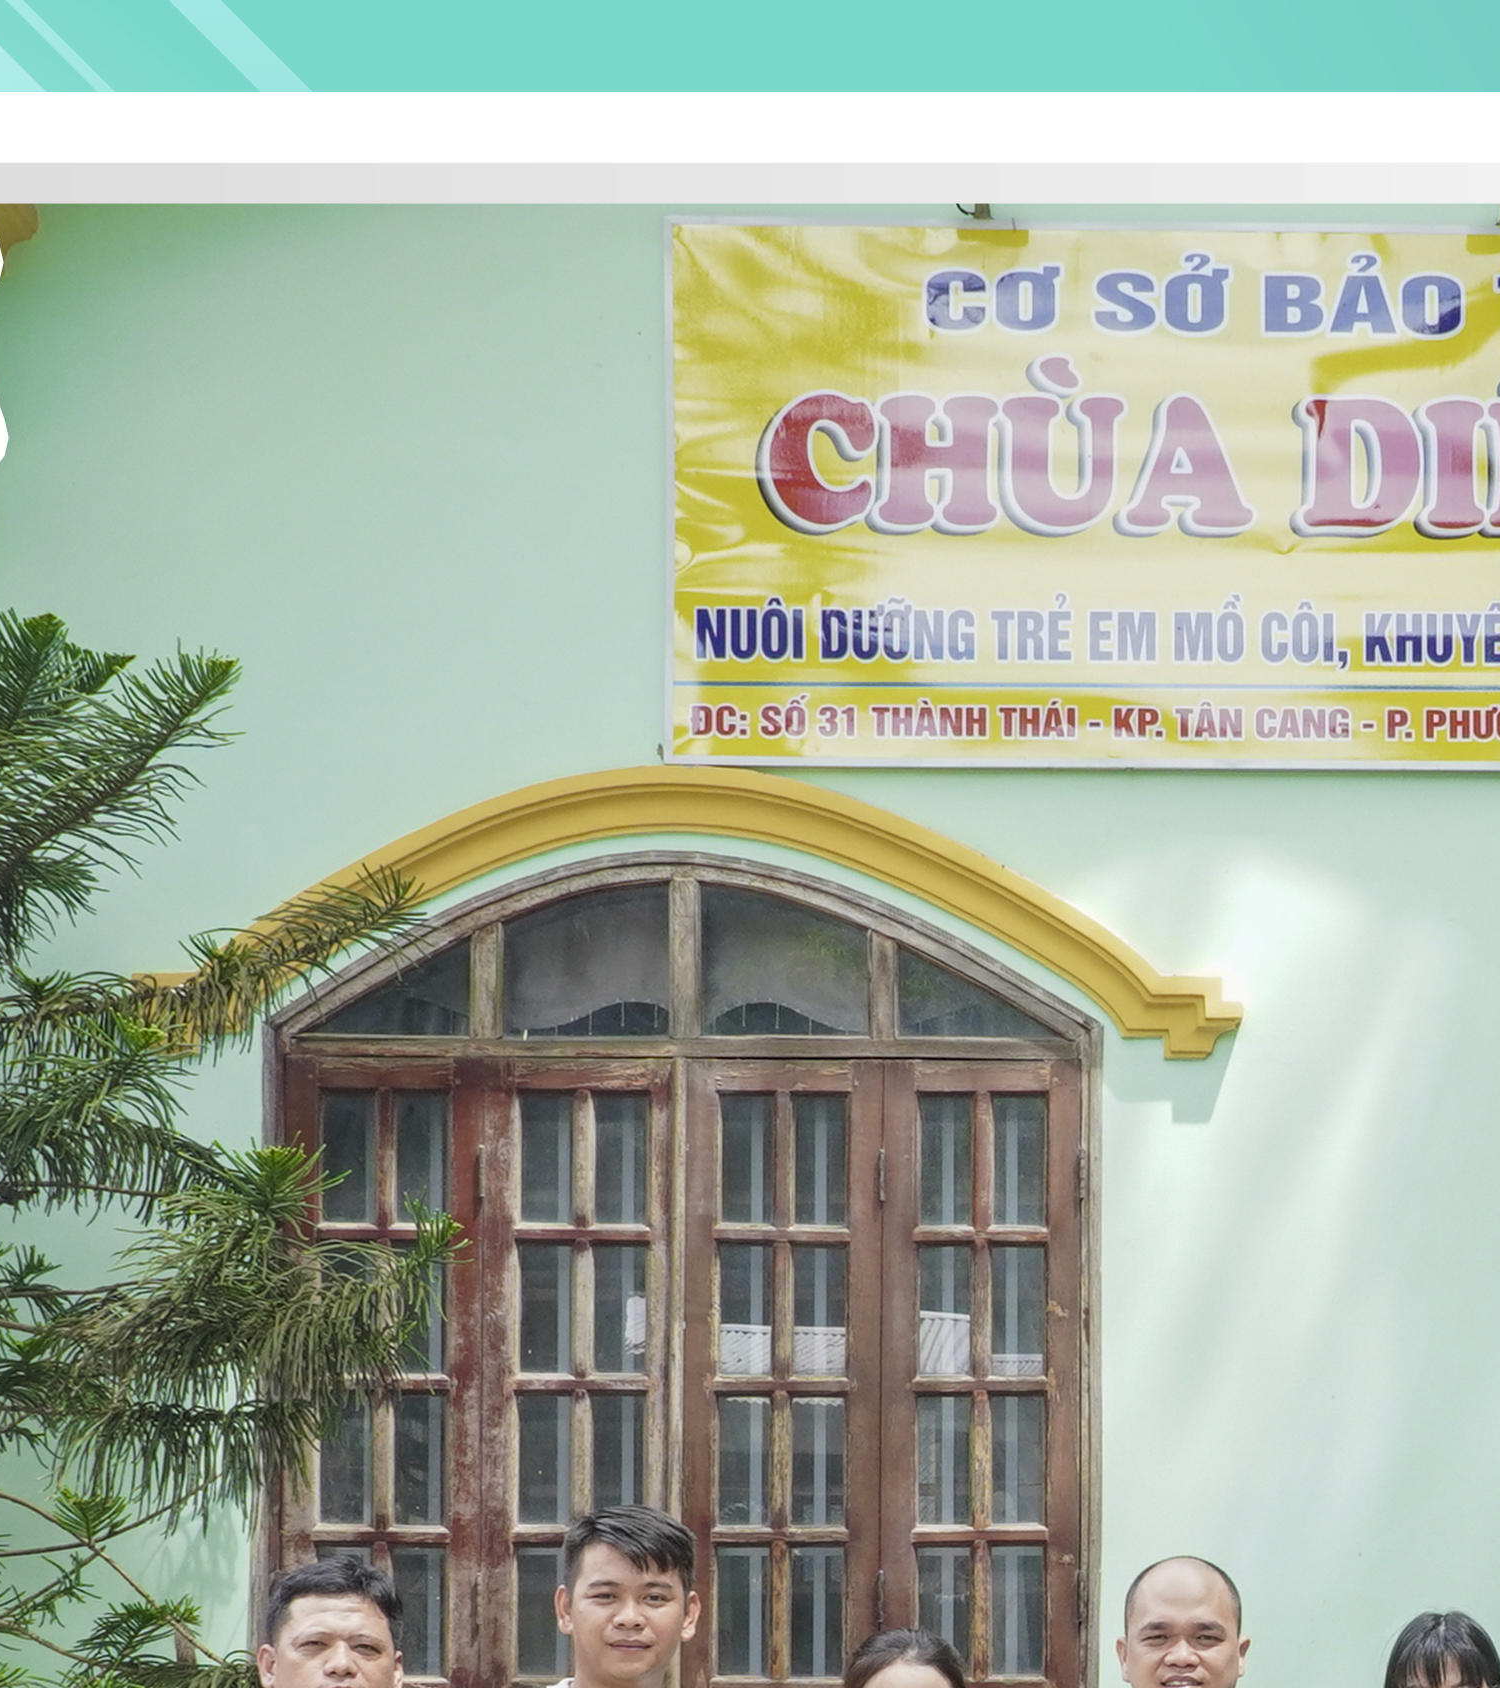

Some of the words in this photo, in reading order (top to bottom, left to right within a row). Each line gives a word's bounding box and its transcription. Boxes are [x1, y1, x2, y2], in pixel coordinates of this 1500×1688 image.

[926, 268, 1059, 333] CƠ
[1096, 254, 1228, 333] SỞ
[1265, 254, 1463, 336] BẢO
[759, 354, 1254, 537] CHÙA
[696, 597, 804, 661] NUÔI
[820, 596, 975, 662] DƯỠNG
[992, 592, 1072, 661] TRẺ
[1089, 610, 1157, 661] EM
[1174, 594, 1245, 664] MỒ
[1260, 600, 1349, 671] CÔI,
[691, 705, 748, 736] ĐC:
[760, 695, 808, 736] SỐ
[818, 706, 855, 736] 31
[873, 701, 987, 737] THÀNH
[999, 699, 1076, 737] THÁI
[1113, 706, 1163, 738] KP.
[1175, 702, 1244, 738] TÂN
[1256, 709, 1350, 738] CANG
[1387, 709, 1412, 739] P.
